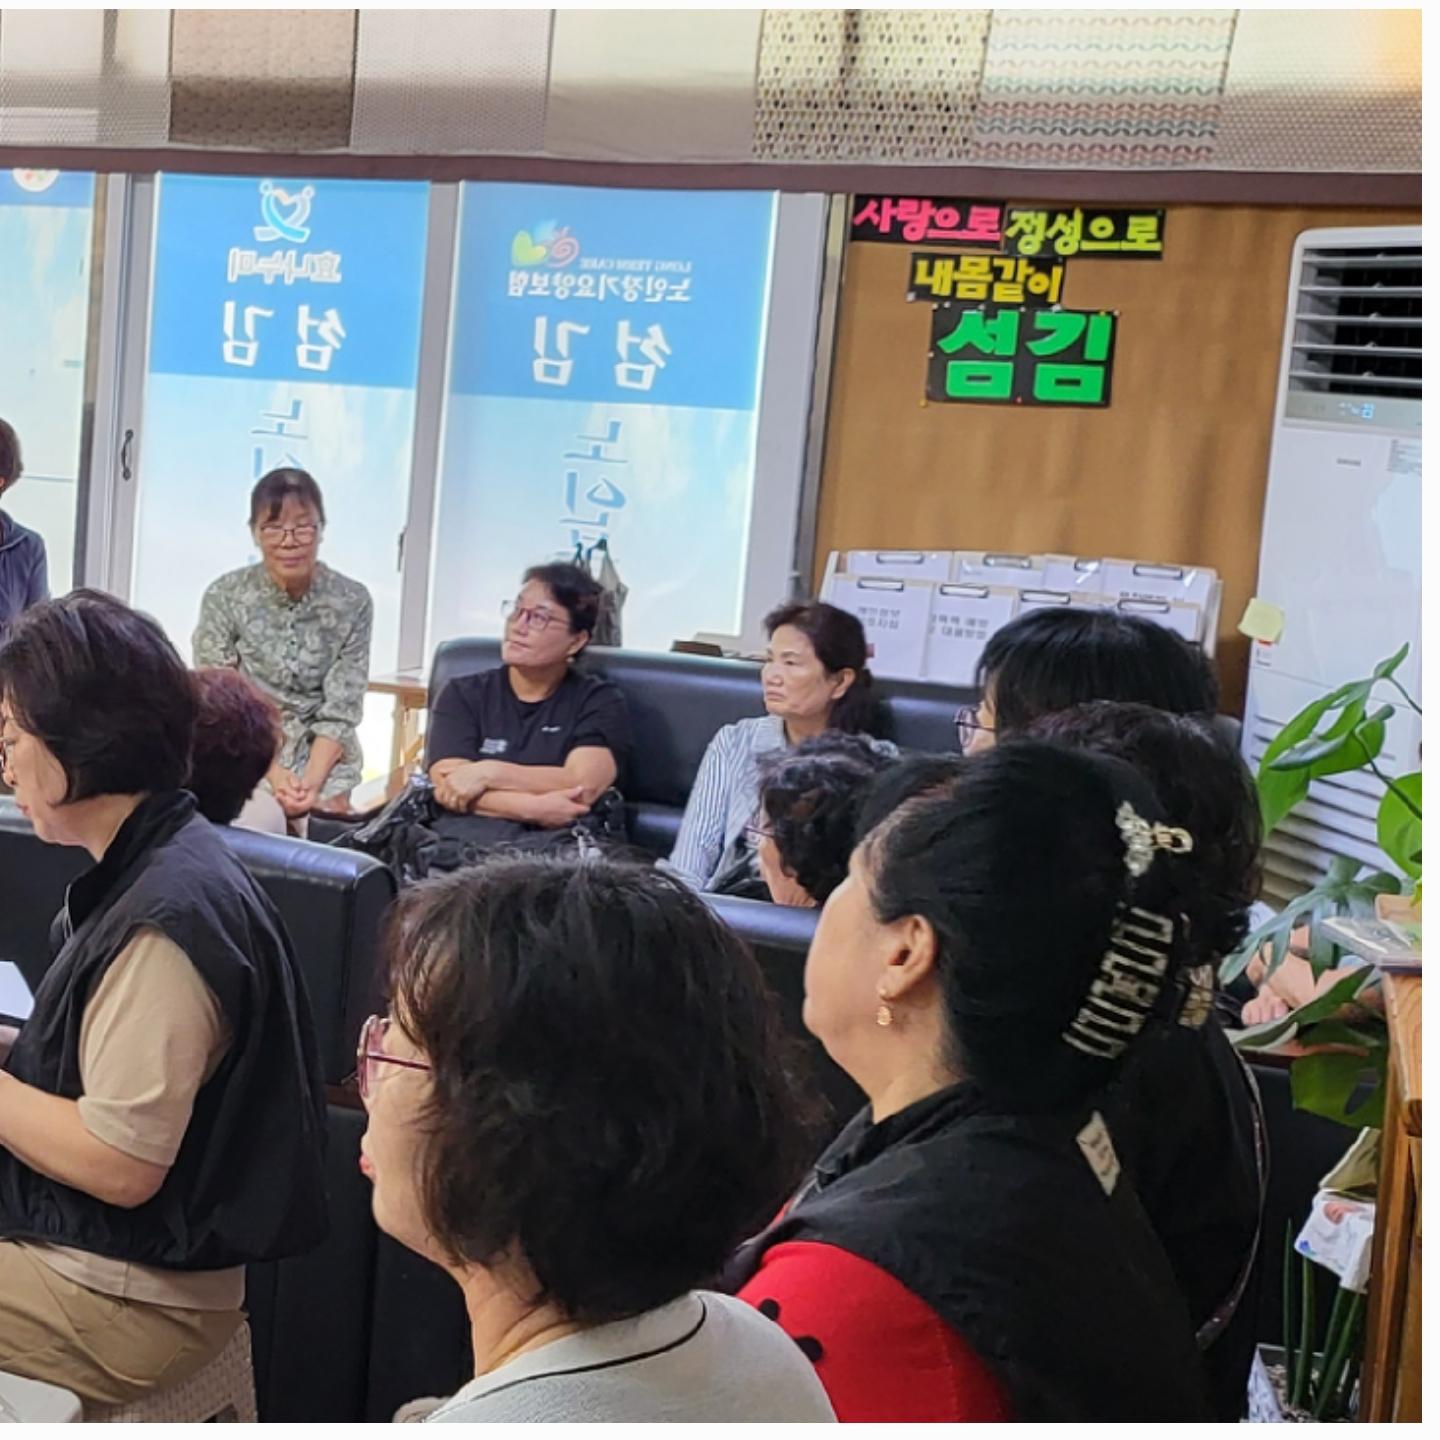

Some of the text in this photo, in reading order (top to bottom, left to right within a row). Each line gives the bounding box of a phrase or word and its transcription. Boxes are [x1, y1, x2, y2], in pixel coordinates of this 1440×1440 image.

[853, 198, 1162, 255] 사랑으로 정성으로
[914, 255, 1062, 303] 내몸같이
[936, 310, 1113, 403] 섬김
